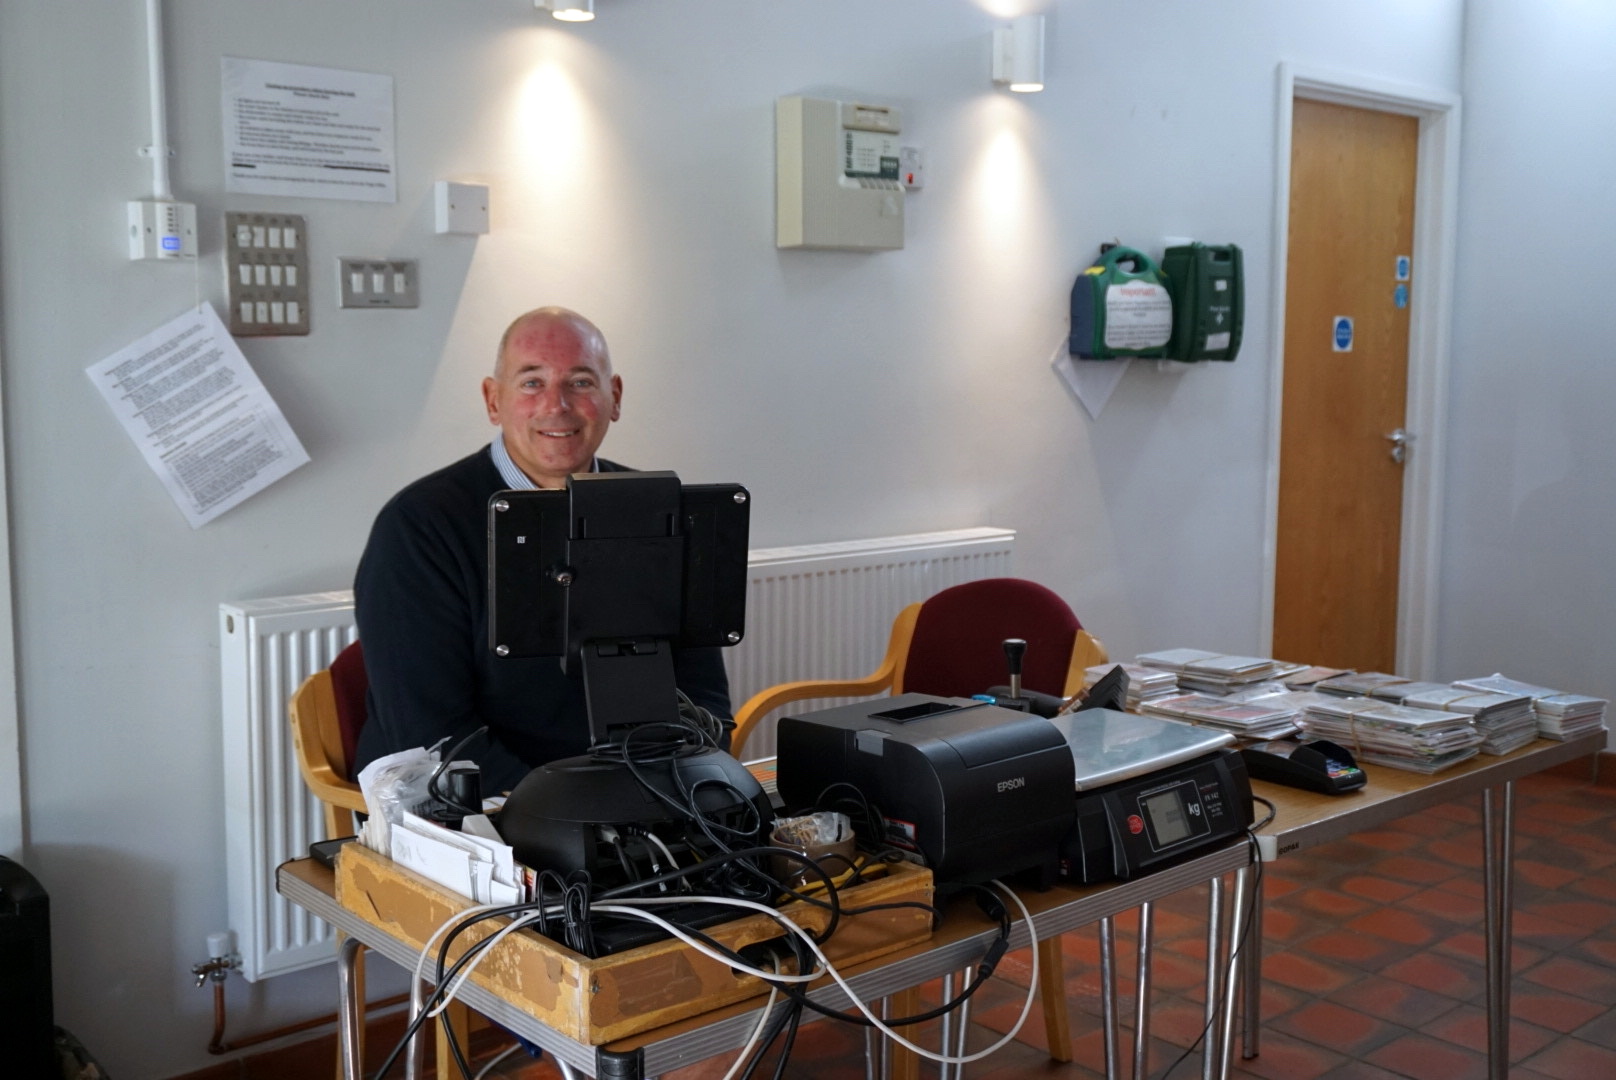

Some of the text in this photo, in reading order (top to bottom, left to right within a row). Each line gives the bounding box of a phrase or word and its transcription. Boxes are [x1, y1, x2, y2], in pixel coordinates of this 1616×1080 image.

[997, 777, 1025, 793] EPSON
[1188, 803, 1201, 816] kg
[1278, 841, 1300, 855] GOPAK
